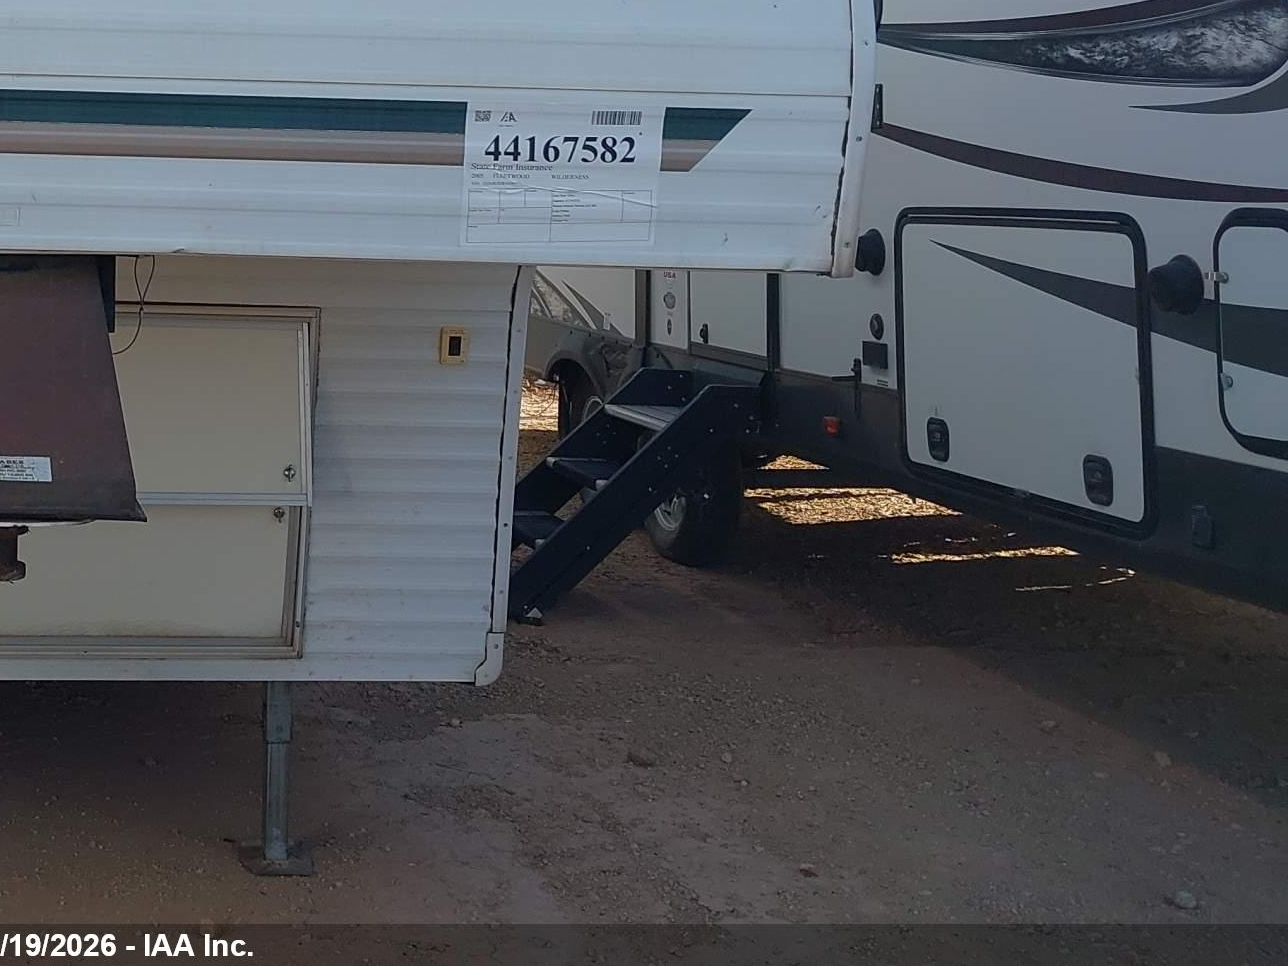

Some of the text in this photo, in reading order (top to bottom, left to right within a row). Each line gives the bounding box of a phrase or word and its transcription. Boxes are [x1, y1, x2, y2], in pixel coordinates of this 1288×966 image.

[484, 134, 636, 164] 44167582
[471, 162, 490, 170] State
[515, 163, 553, 172] Insurance
